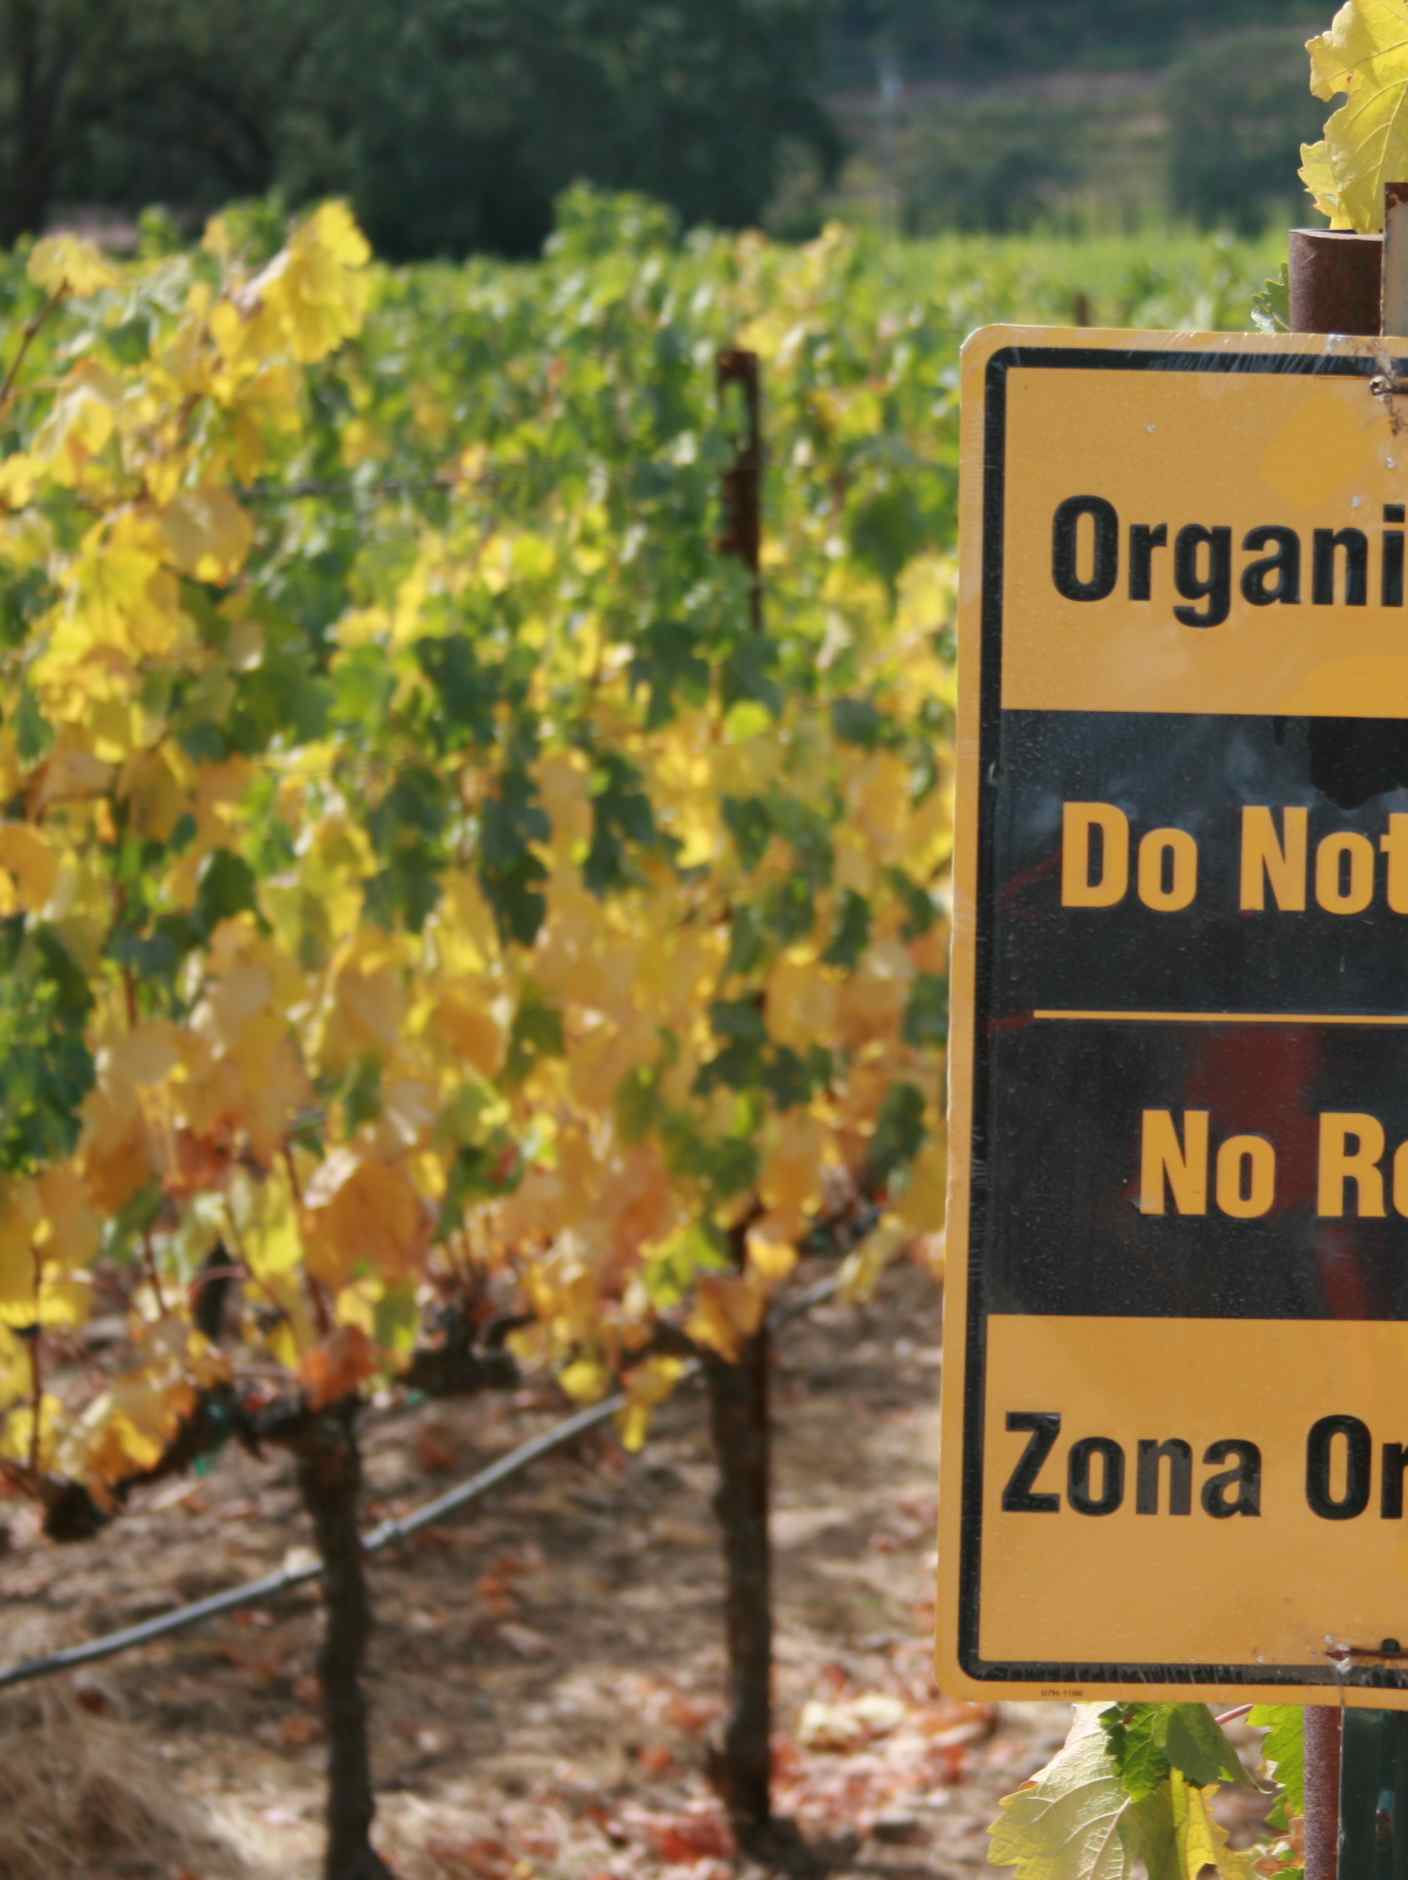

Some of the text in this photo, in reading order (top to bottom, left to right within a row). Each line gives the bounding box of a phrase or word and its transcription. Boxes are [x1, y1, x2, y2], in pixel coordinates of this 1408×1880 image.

[1061, 801, 1197, 911] Do
[1140, 1110, 1276, 1218] No
[1002, 1413, 1262, 1517] Zona
